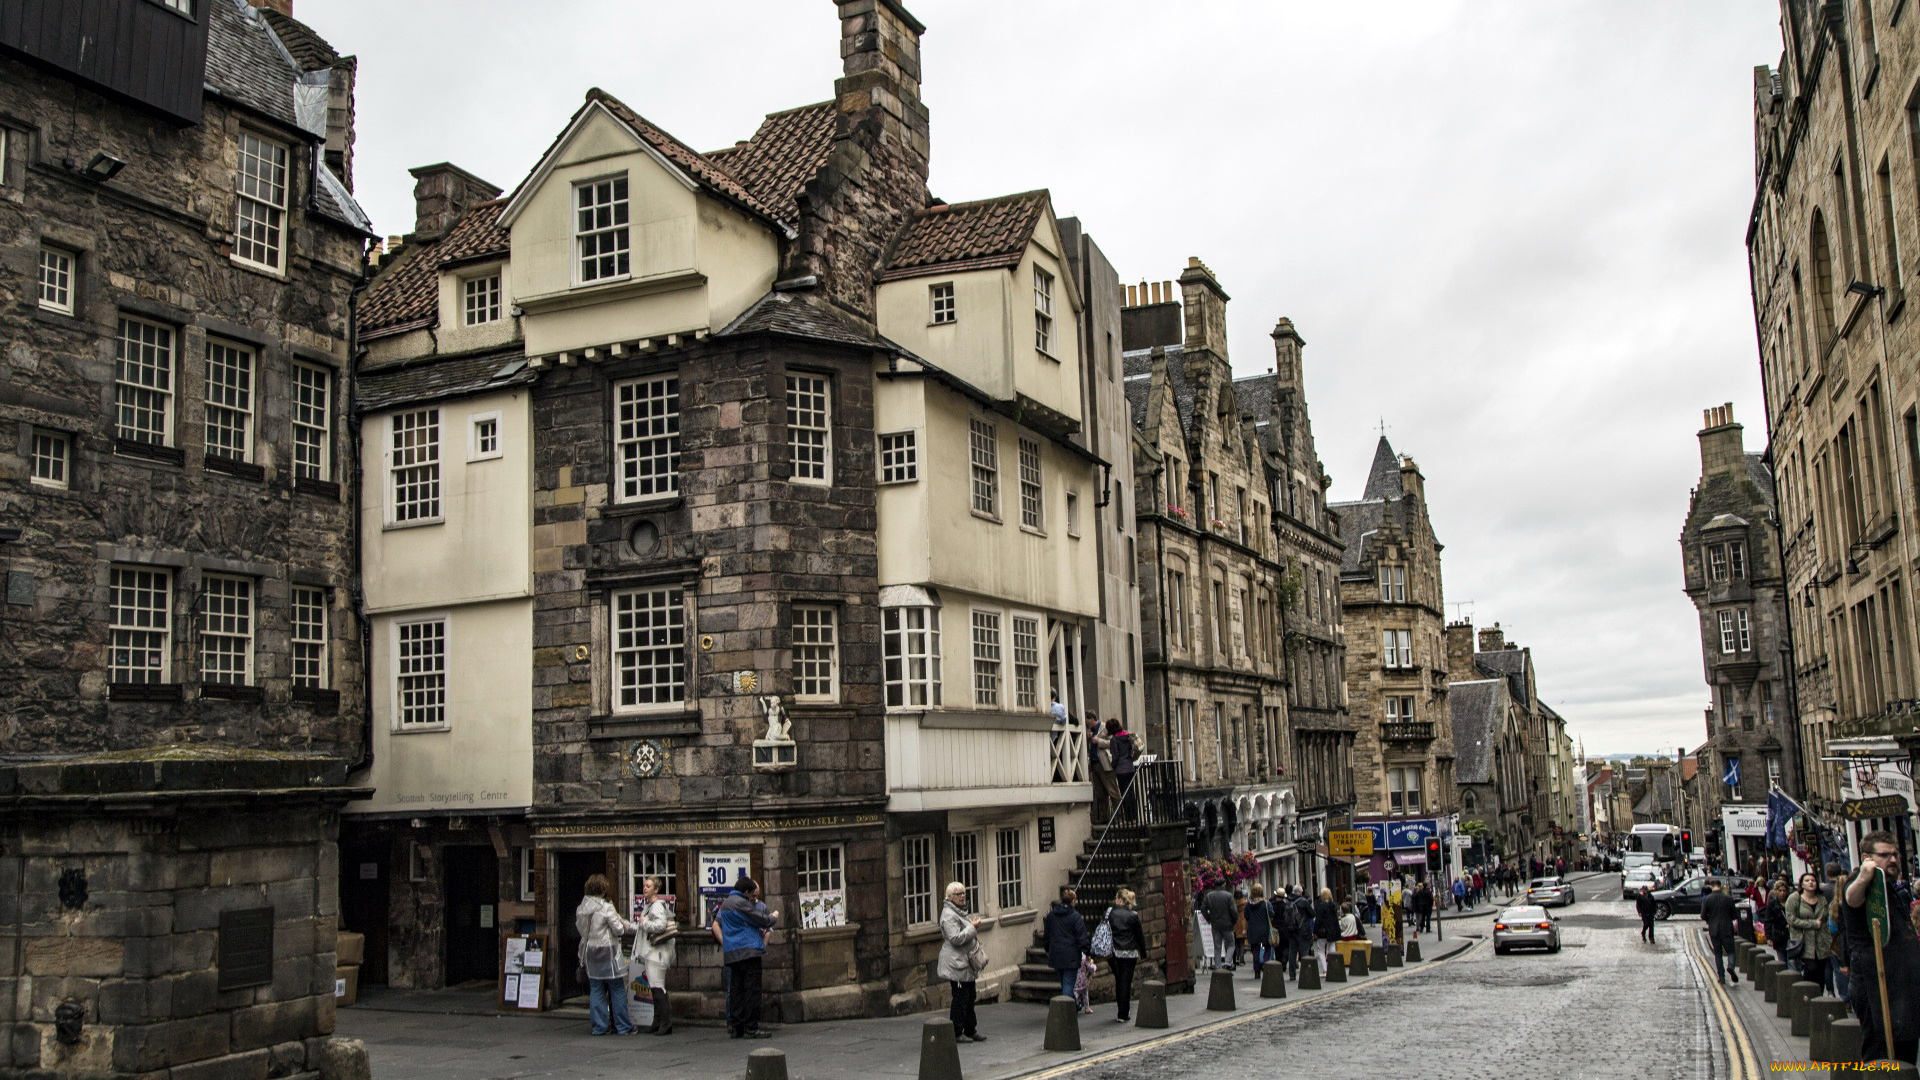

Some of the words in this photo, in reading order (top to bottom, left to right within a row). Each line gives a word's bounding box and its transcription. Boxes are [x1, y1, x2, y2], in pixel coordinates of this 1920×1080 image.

[397, 793, 425, 803] Scottish
[429, 791, 474, 804] Storytelling
[480, 790, 508, 800] Centre
[1863, 796, 1900, 807] SALTIRE
[1864, 806, 1903, 816] SOCIETY
[591, 825, 609, 833] GOD
[817, 816, 839, 825] SELF
[707, 866, 727, 885] 30
